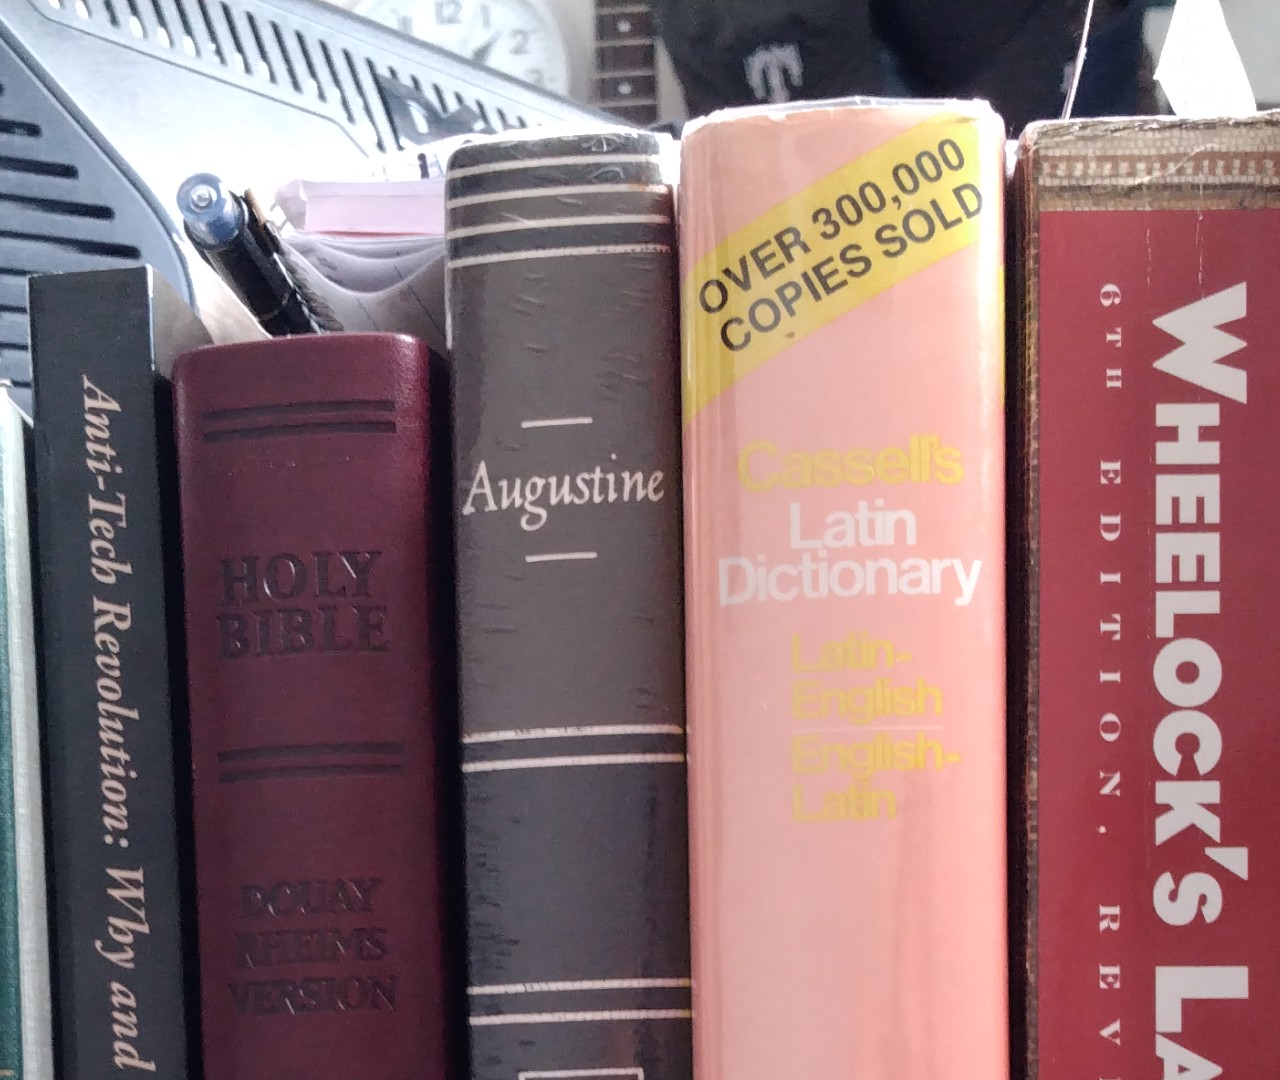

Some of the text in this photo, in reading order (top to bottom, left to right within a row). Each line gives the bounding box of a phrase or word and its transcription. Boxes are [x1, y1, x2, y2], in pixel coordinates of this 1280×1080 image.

[699, 138, 966, 314] OVER 300,000
[720, 183, 983, 351] COPIES SOLD
[1099, 282, 1122, 389] 6TH
[83, 373, 133, 586] Anti-Tech
[463, 453, 664, 531] Augustine
[737, 434, 965, 492] Cassell's
[789, 499, 916, 550] Latin
[220, 550, 382, 602] HOLY
[719, 548, 982, 606] Dictionary
[1151, 281, 1249, 926] WHEELOCK'S
[216, 606, 388, 658] BIBLE
[791, 631, 913, 674] Latin-
[1096, 458, 1121, 834] EDITION.
[93, 595, 140, 848] Revolution:
[792, 677, 943, 725] English
[792, 730, 961, 780] English-
[793, 778, 897, 822] Latin
[94, 865, 151, 969] Why
[238, 878, 383, 917] DOUAY
[234, 928, 388, 967] RHEIMS
[227, 975, 399, 1016] VERSION
[110, 981, 157, 1072] and
